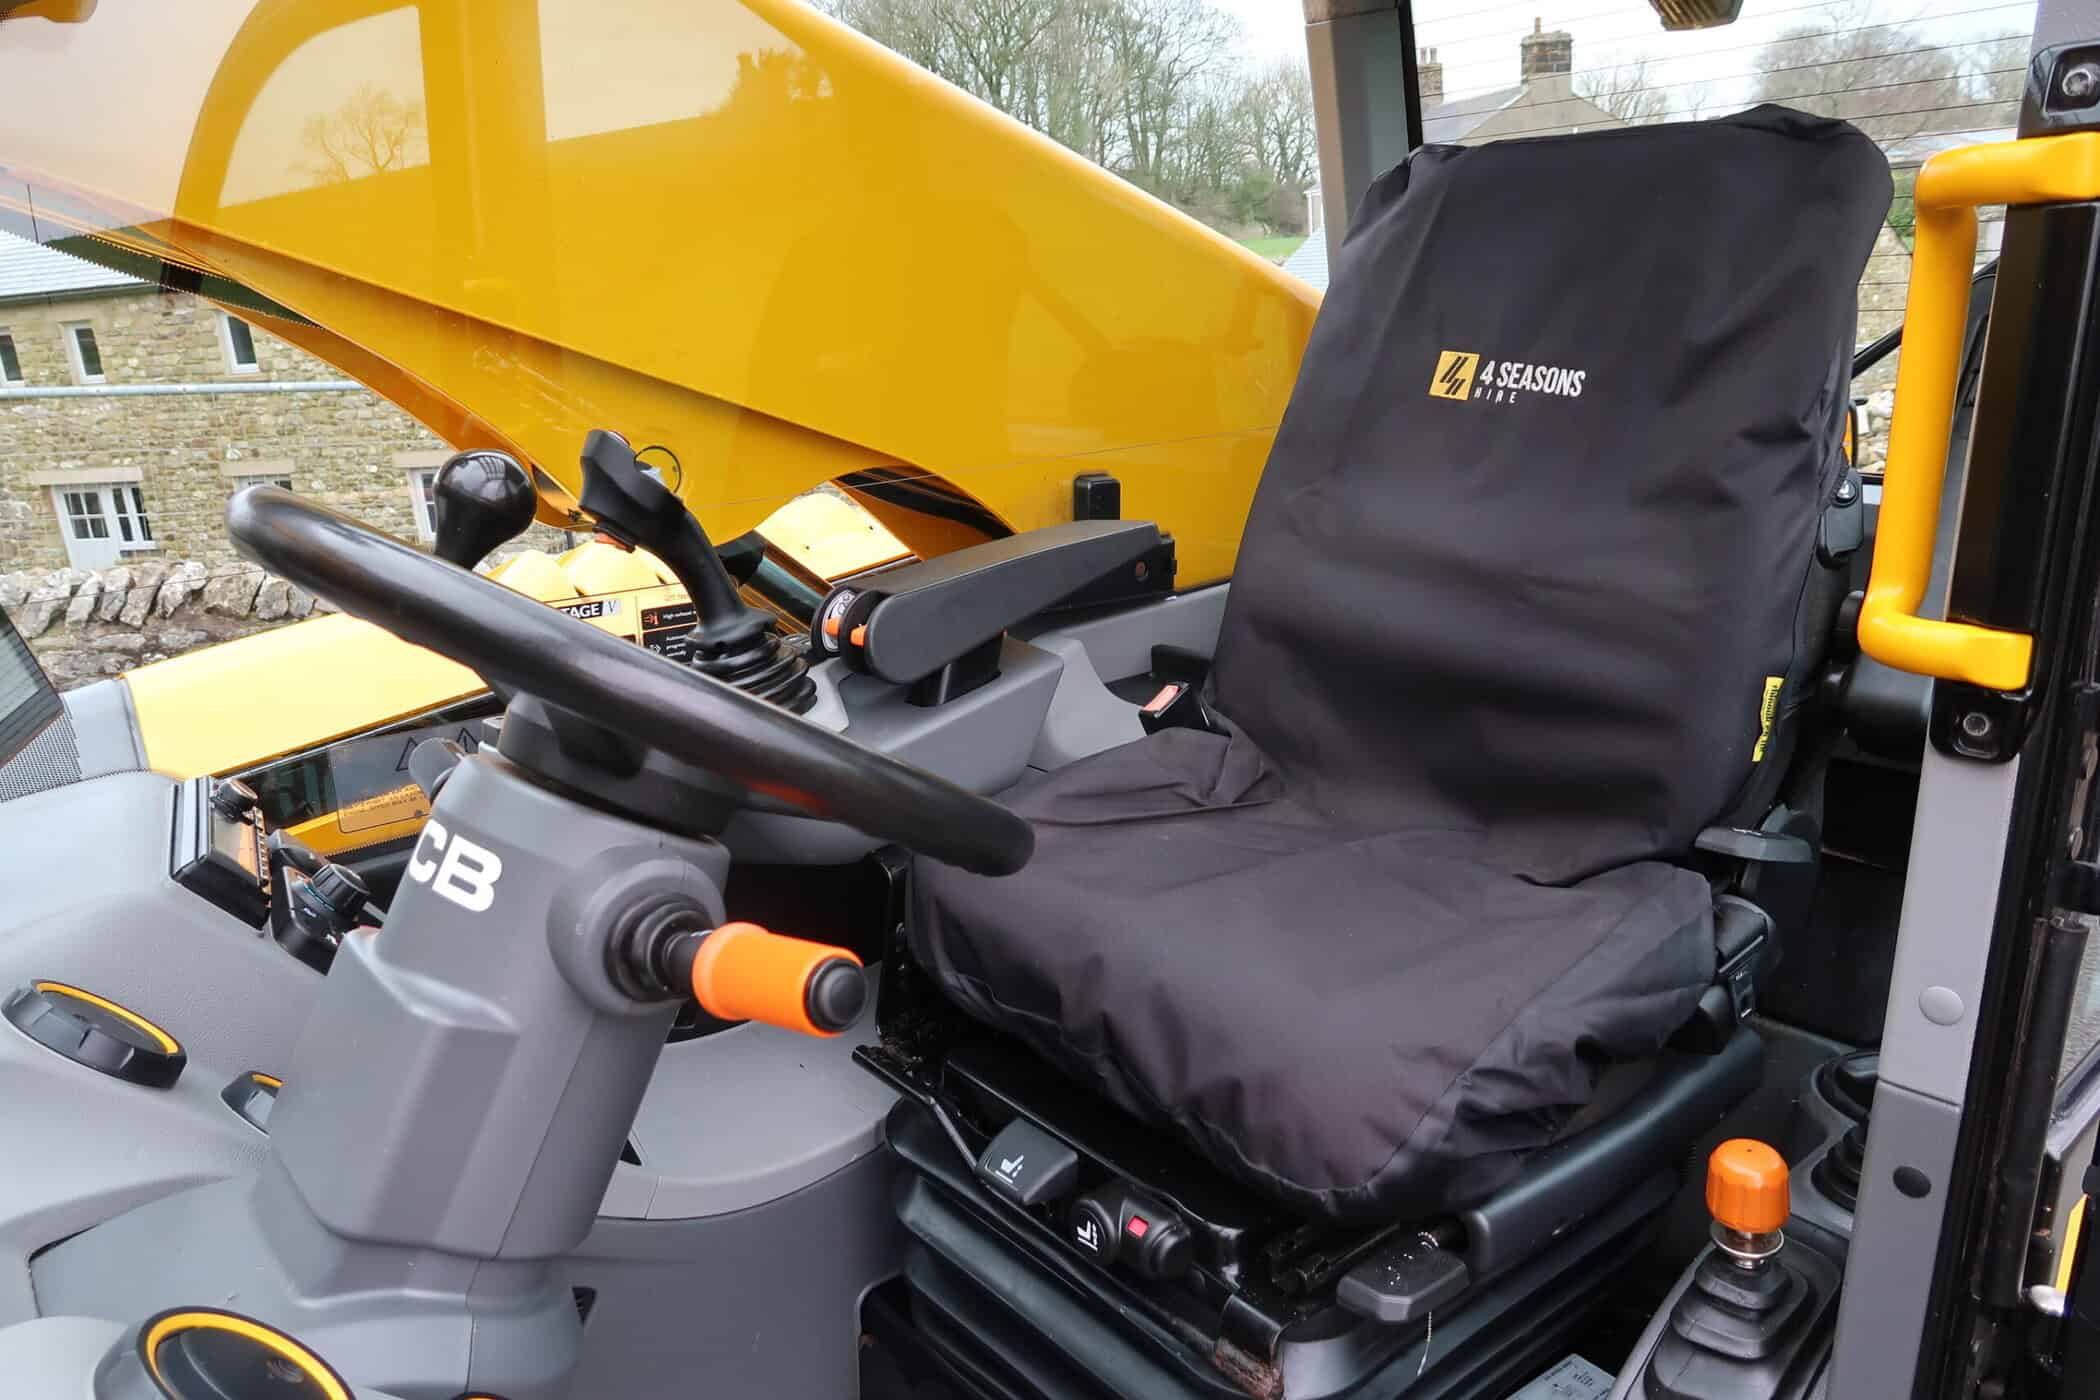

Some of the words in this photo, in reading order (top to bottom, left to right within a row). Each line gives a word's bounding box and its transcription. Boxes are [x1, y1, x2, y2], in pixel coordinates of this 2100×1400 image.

[1480, 361, 1495, 385] 4
[1496, 362, 1586, 397] SEASONS
[1474, 387, 1518, 404] HIRE
[560, 603, 601, 618] TAGE
[409, 818, 503, 912] CB
